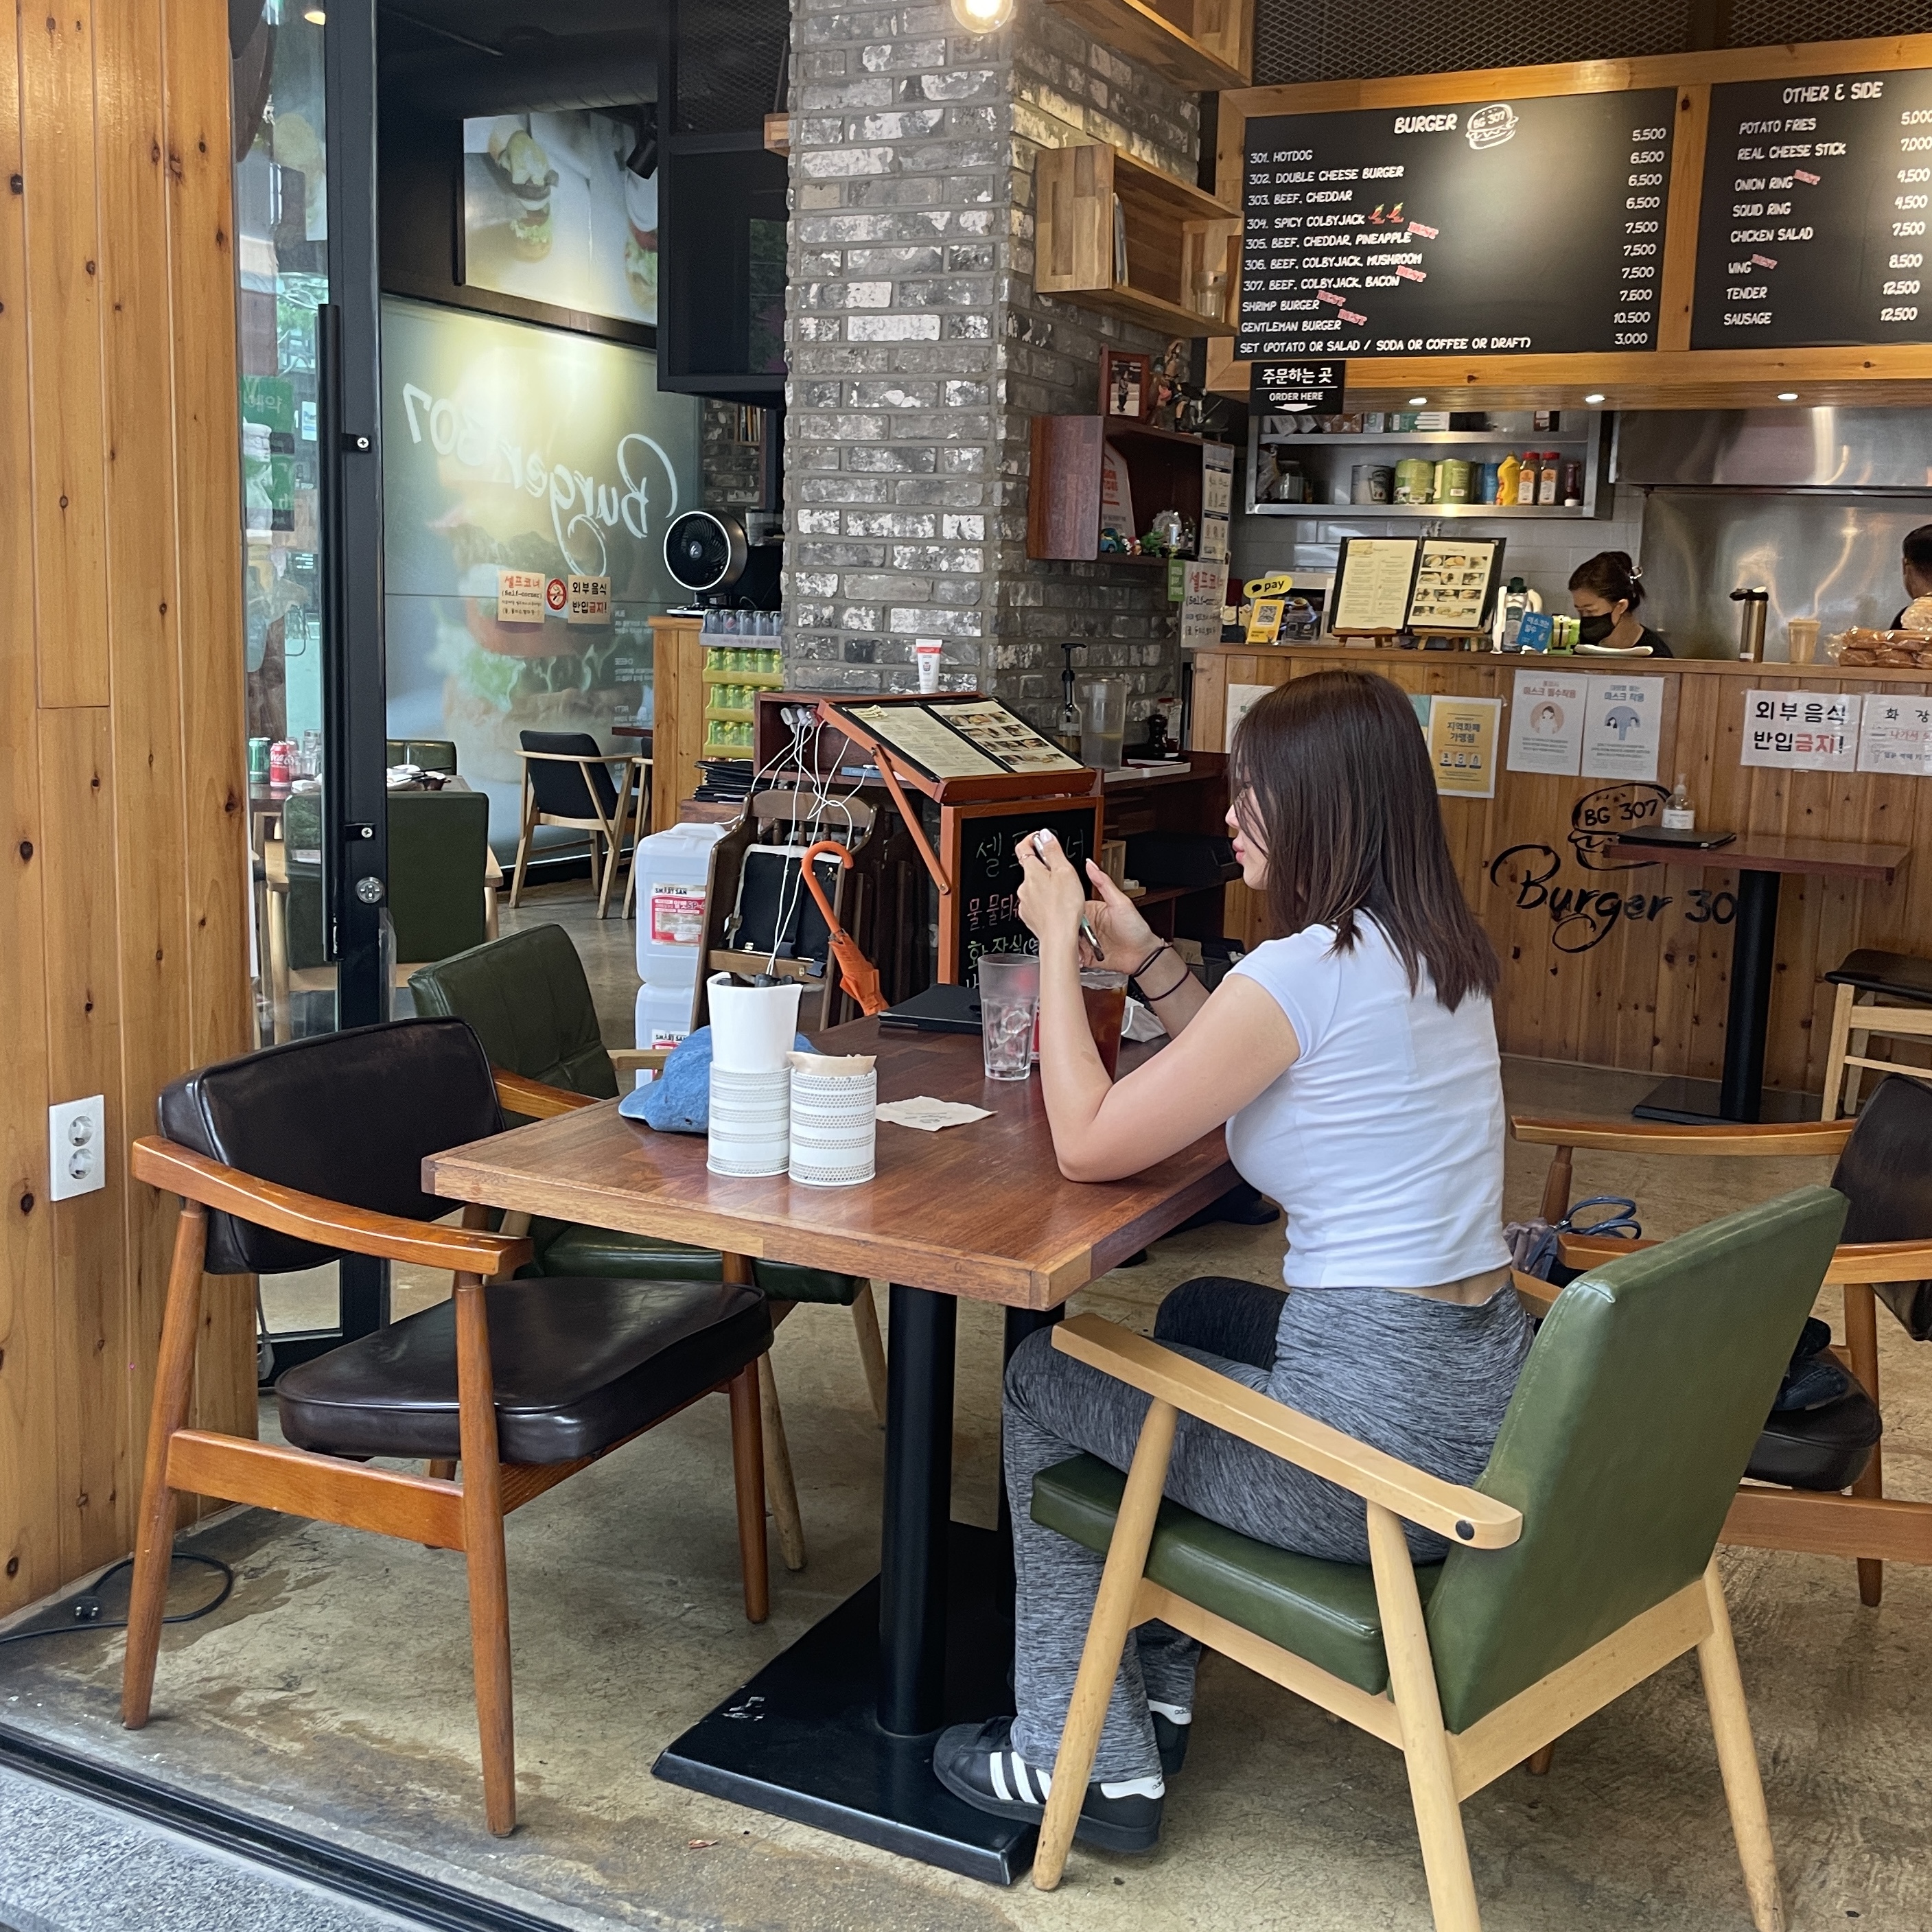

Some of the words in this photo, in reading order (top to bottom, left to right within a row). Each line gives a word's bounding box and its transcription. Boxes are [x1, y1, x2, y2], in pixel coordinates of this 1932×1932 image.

[1783, 84, 1829, 104] OTHER
[1851, 82, 1883, 99] SIDE
[1394, 113, 1458, 135] BURGER
[1487, 110, 1506, 125] 307
[1739, 120, 1781, 135] POTATO
[1784, 118, 1817, 131] FRIES
[1273, 150, 1313, 162] HOTDOG
[1737, 148, 1765, 161] REAL
[1769, 145, 1811, 159] CHEESE
[1815, 142, 1846, 156] STICK
[1249, 174, 1270, 185] 302.
[1275, 172, 1314, 184] DOUBLE
[1318, 169, 1358, 181] CHEESE
[1362, 166, 1404, 179] BURGER
[1734, 178, 1765, 191] ONION
[1769, 176, 1793, 189] RING
[1248, 195, 1270, 206] 303.
[1306, 190, 1353, 203] CHEDDAR
[1767, 202, 1791, 216] RING
[1274, 217, 1303, 229] SPICY
[1306, 214, 1365, 227] COLBYJACK
[1246, 239, 1267, 249] 305.
[1355, 232, 1412, 245] PINEAPPLE
[1730, 229, 1773, 242] CHICKEN
[1778, 226, 1813, 240] SALAD
[1244, 260, 1266, 270] 306.
[1366, 253, 1423, 266] MUSHROOM
[1244, 280, 1265, 291] 307.
[1365, 275, 1400, 288] BACON
[1726, 286, 1768, 300] TENDER
[1242, 301, 1277, 312] SHRIMP
[1280, 300, 1319, 311] BURGER
[1242, 321, 1299, 332] GENTLEMAN
[1302, 320, 1342, 331] BURGER
[1724, 312, 1772, 325] SAUSAGE
[1240, 343, 1259, 353] SET
[1309, 341, 1323, 352] OR
[1326, 340, 1360, 351] SALAD
[1376, 340, 1404, 351] SODA
[1408, 339, 1422, 350] OR
[1425, 338, 1468, 350] COFFEE
[1471, 338, 1487, 349] OR
[1262, 367, 1315, 384] 주문하는
[1318, 367, 1333, 384] 곳
[1269, 393, 1299, 401] ORDER
[1301, 391, 1323, 401] HERE
[504, 576, 539, 588] 셀프코너
[1264, 580, 1285, 592] pay
[1584, 805, 1611, 826] BG
[1620, 798, 1658, 822] 307
[1490, 844, 1673, 953] Burger
[1685, 888, 1737, 924] 30
